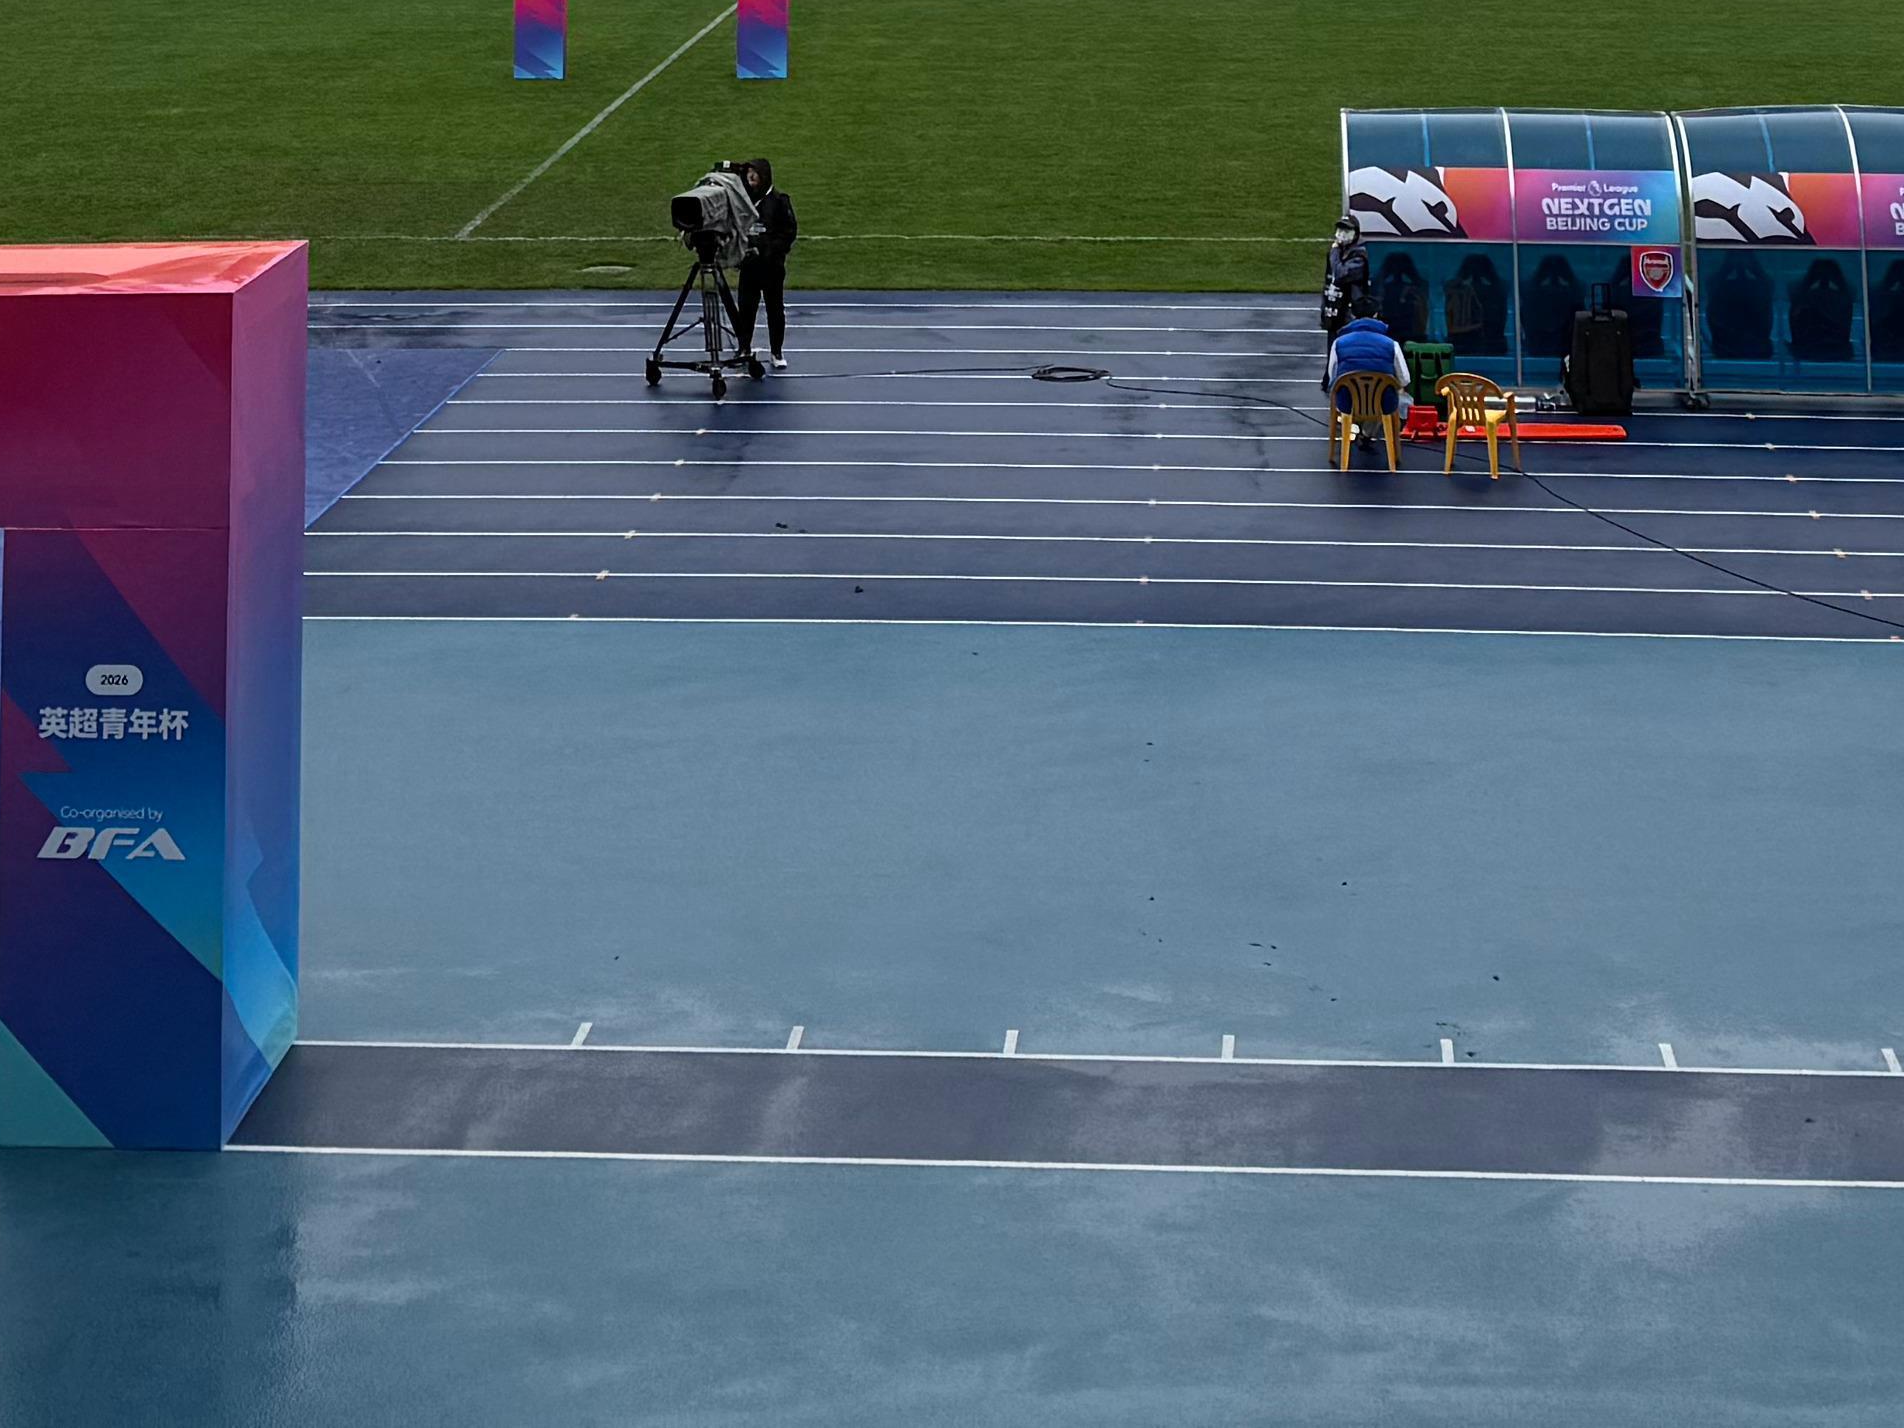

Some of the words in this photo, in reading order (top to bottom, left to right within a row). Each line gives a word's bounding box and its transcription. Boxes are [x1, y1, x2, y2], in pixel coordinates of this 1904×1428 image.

[1552, 182, 1586, 192] Premier
[1603, 183, 1638, 194] League
[1541, 199, 1652, 216] NEXTGEN
[1546, 217, 1610, 231] BEIJING
[1614, 219, 1648, 231] CUP
[100, 674, 129, 686] 2026
[39, 707, 189, 740] 英超青年杯
[60, 805, 145, 821] Co-organised
[147, 807, 163, 821] by
[36, 826, 186, 861] BFA
